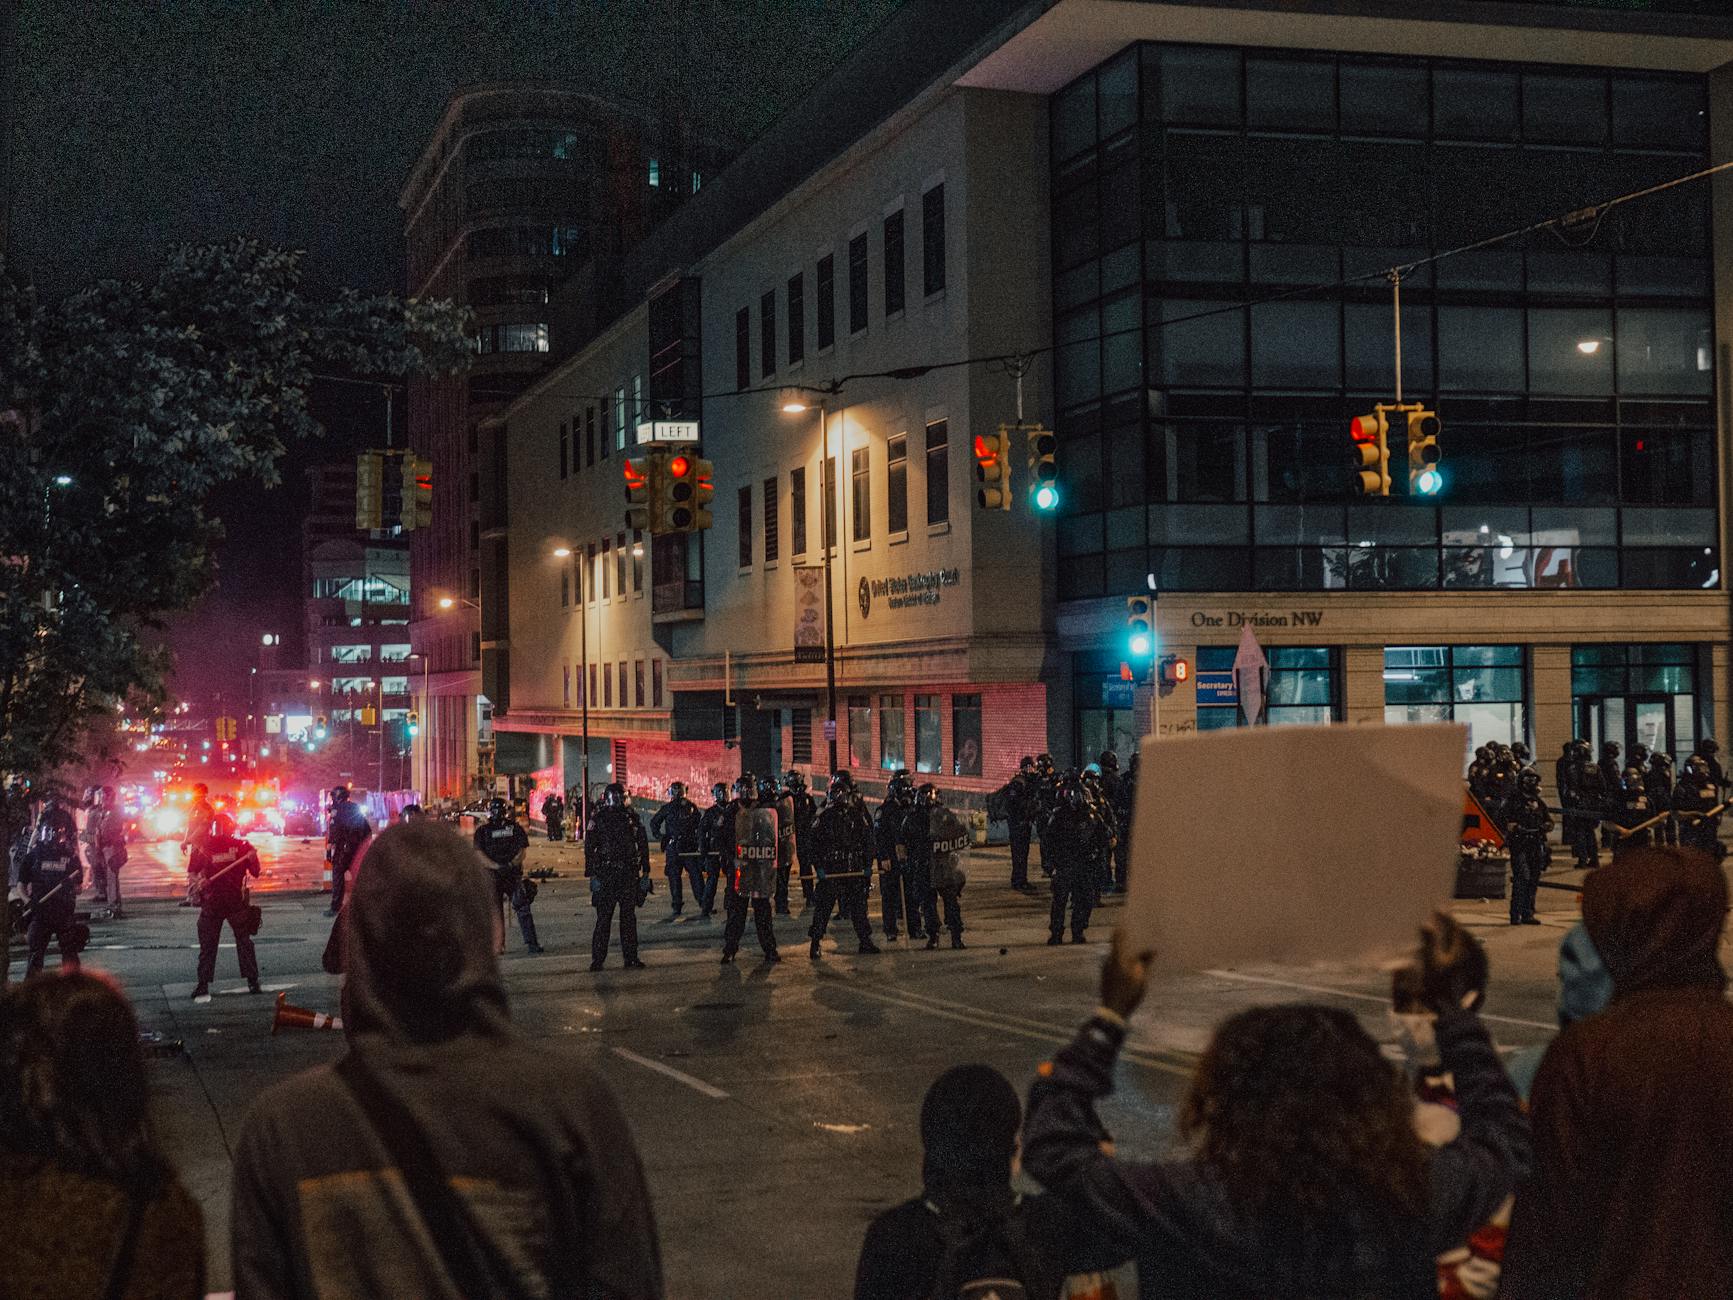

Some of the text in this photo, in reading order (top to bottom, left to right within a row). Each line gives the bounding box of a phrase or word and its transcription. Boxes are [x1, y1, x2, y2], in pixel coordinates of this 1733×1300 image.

[662, 425, 690, 438] LEFT
[1191, 611, 1323, 627] One Division NW
[1197, 681, 1233, 690] Secretary
[933, 834, 970, 853] POLICE
[740, 846, 776, 859] POLICE
